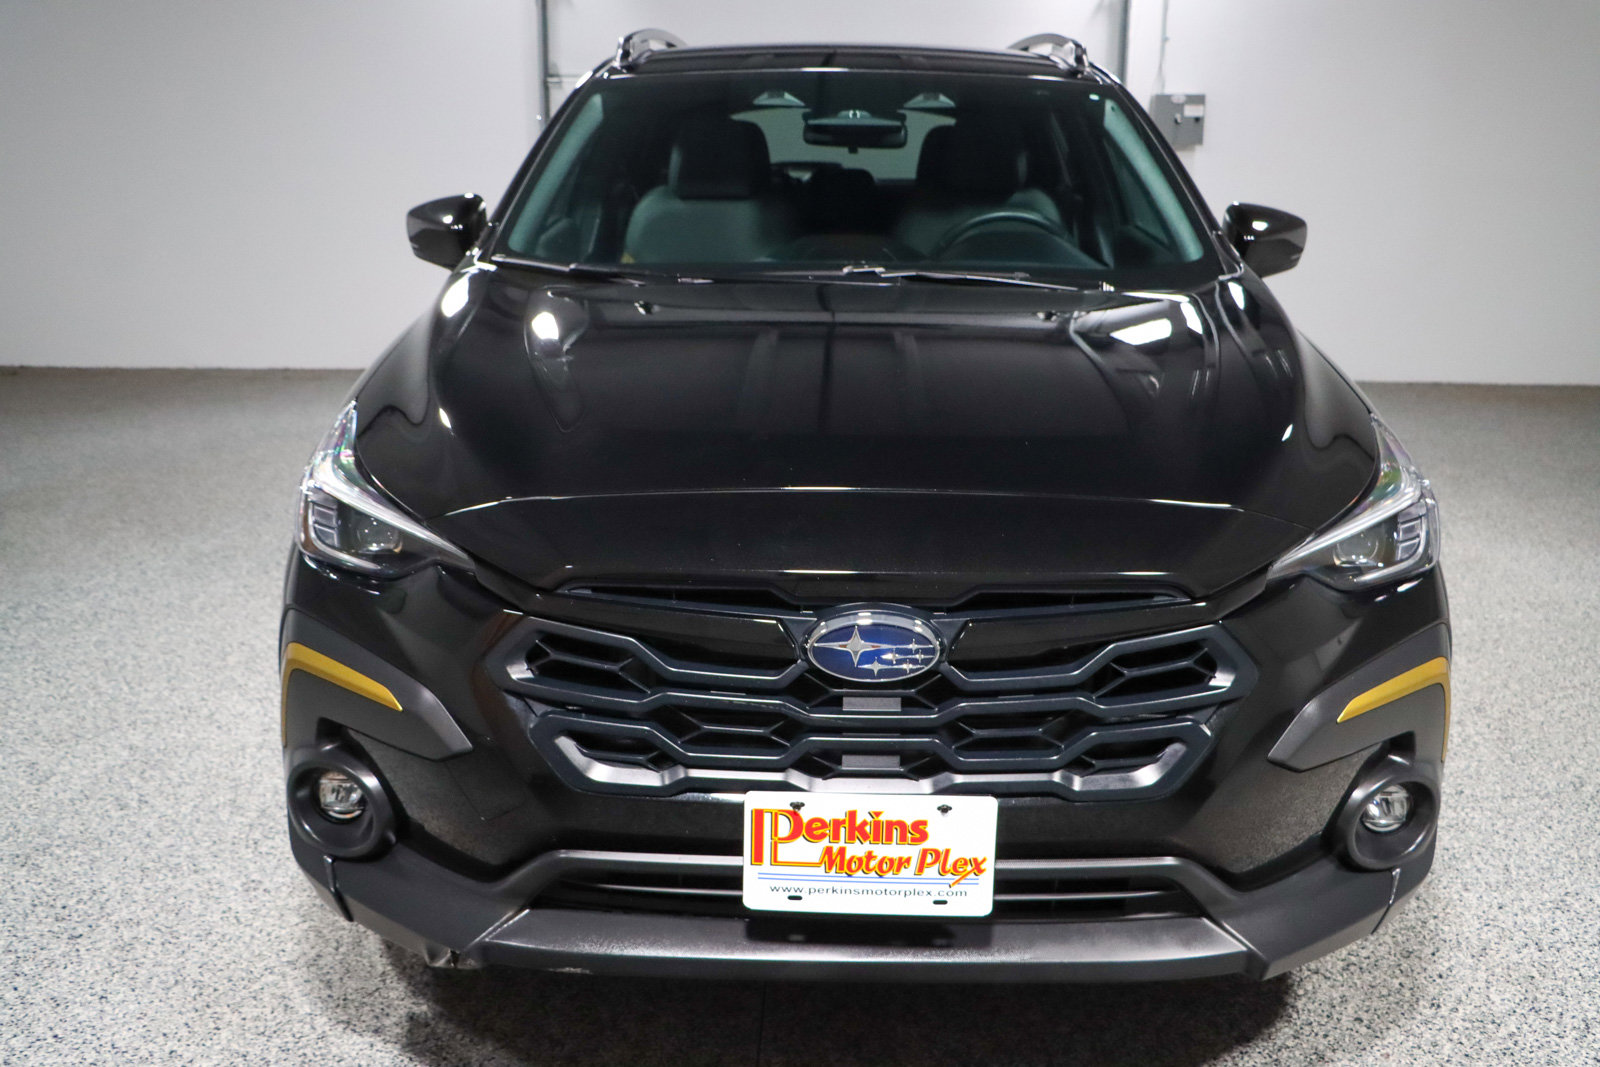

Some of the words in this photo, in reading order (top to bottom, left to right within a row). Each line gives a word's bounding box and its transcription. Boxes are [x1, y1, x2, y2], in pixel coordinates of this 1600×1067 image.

[751, 808, 929, 865] Perkins
[821, 846, 912, 876] Motor
[915, 848, 987, 887] Plex
[769, 885, 968, 898] www.perkinsmotorplex.com
